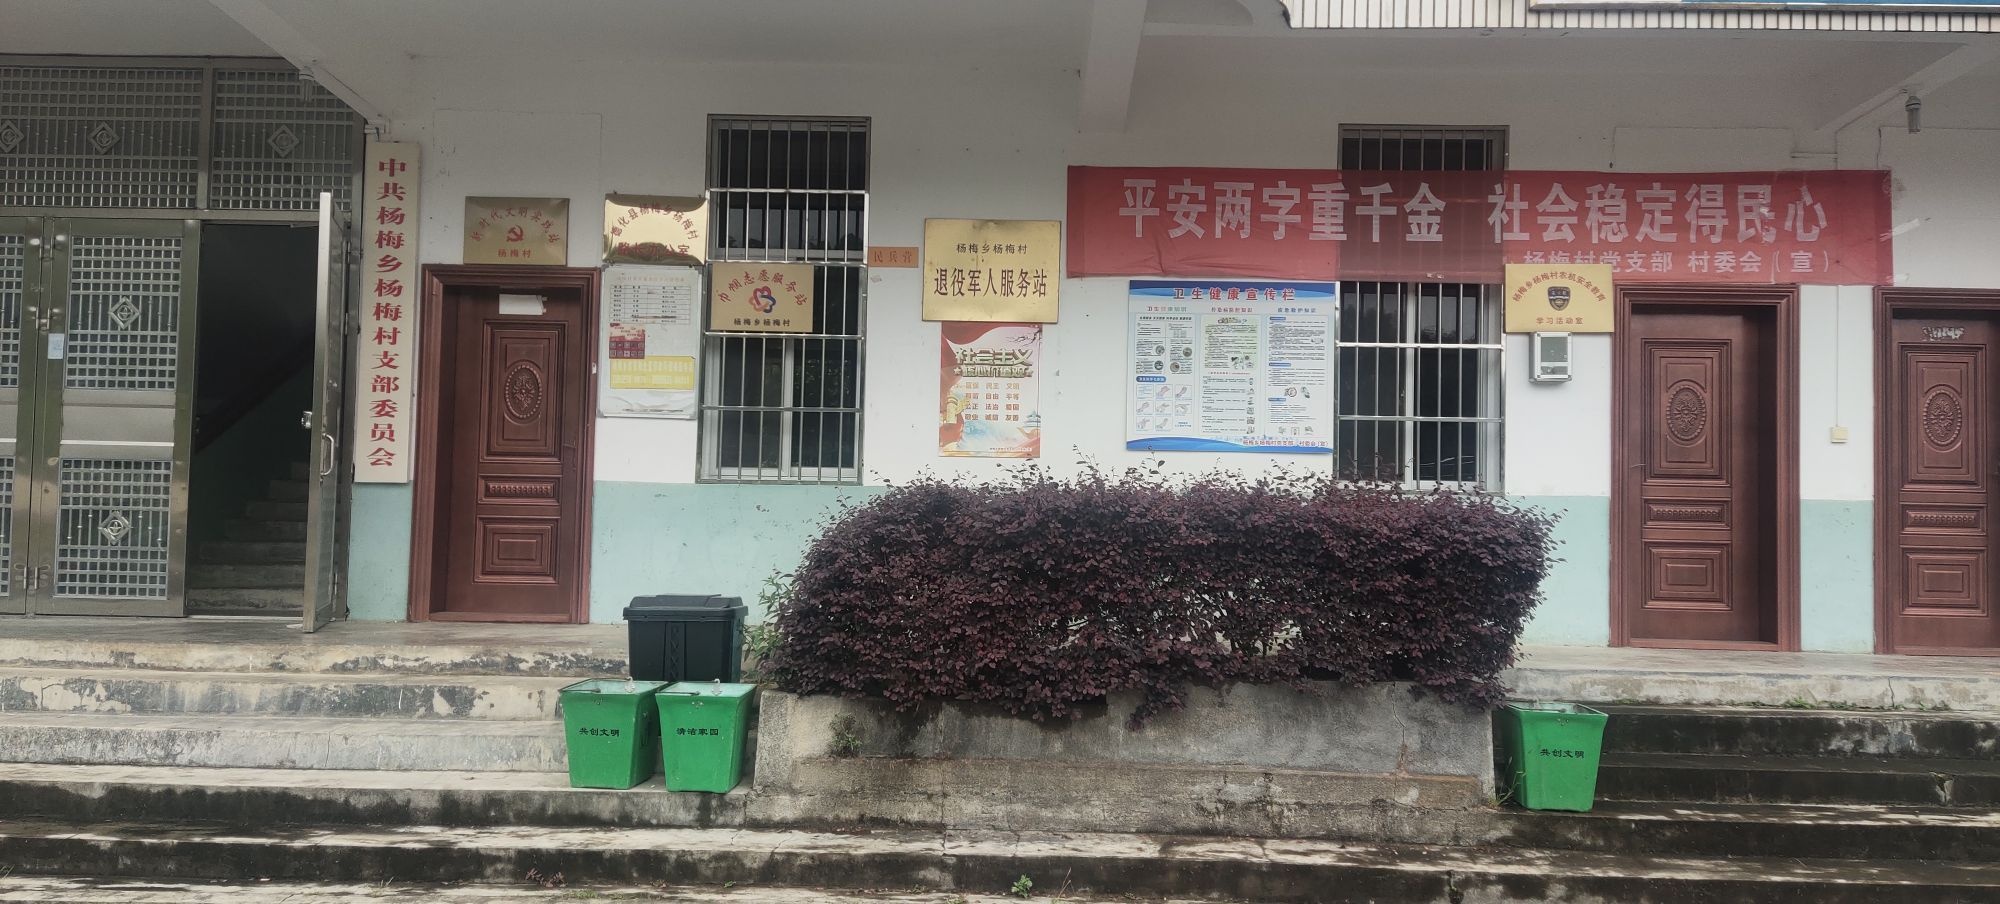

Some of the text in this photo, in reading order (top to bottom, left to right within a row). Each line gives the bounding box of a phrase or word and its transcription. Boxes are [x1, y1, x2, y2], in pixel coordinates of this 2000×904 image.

[1119, 178, 1827, 243] 平安两字重千金 社会稳定得民心
[498, 248, 531, 258] 杨梅村
[956, 243, 1027, 255] 杨梅乡杨梅村
[873, 251, 912, 264] 民兵营
[719, 269, 807, 306] 巾帼志愿服务站
[934, 267, 1048, 298] 退役军人服务站
[1512, 271, 1607, 302] 杨梅乡杨梅村农机安全教育
[1173, 287, 1296, 301] 卫生健康宣传栏
[366, 158, 406, 466] 中共杨梅乡杨梅村支部委员会
[733, 318, 791, 327] 杨梅乡杨梅村
[1536, 317, 1584, 325] 学习活动室
[955, 348, 1033, 366] 社会主义
[985, 392, 999, 400] 自由
[579, 728, 620, 737] 共创文明
[676, 727, 719, 736] 清洁家园
[1540, 748, 1585, 758] 共创文明
